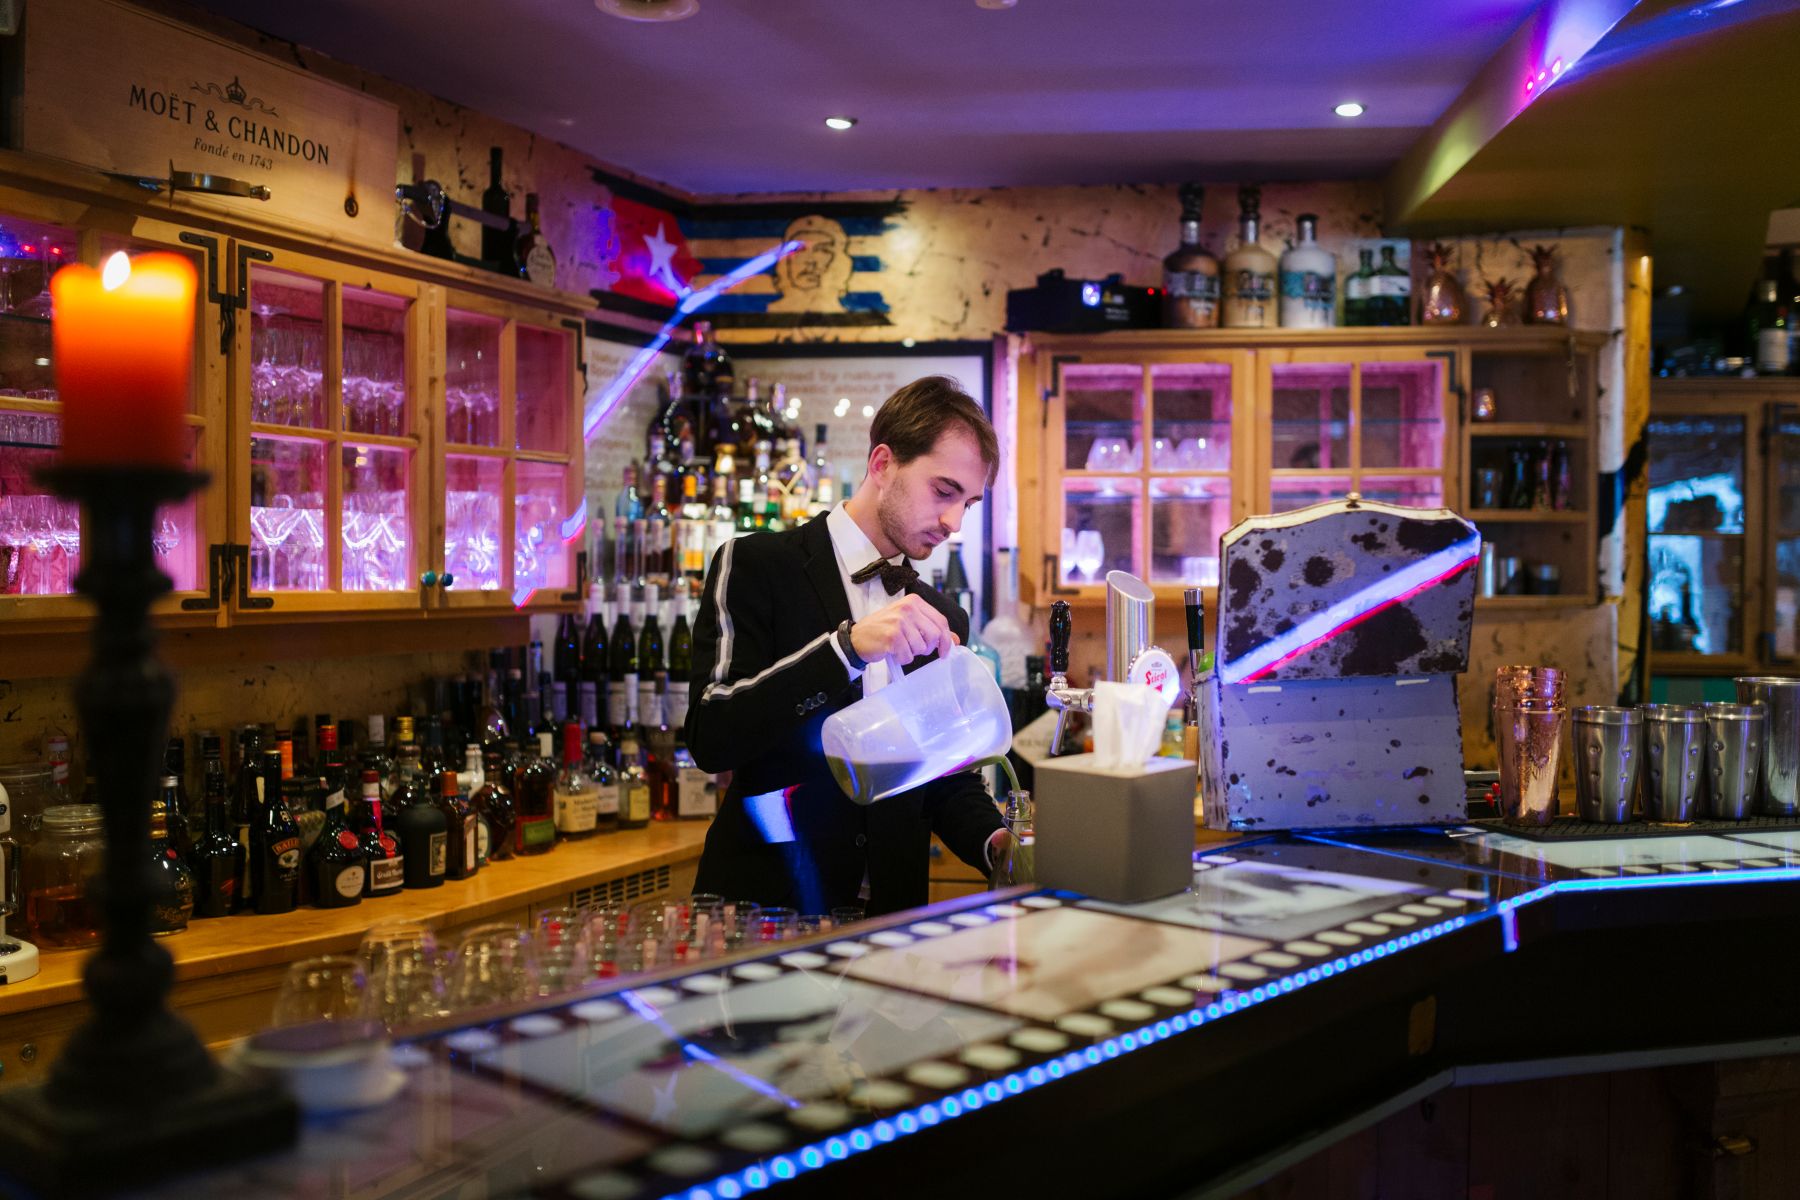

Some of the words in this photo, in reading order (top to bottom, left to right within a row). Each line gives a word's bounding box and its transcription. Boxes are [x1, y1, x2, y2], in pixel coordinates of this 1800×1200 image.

[129, 84, 196, 125] MOËT
[205, 110, 220, 134] &
[228, 116, 330, 166] CHANDON
[193, 137, 229, 158] Fondé
[231, 150, 245, 163] en
[249, 154, 274, 171] 1743
